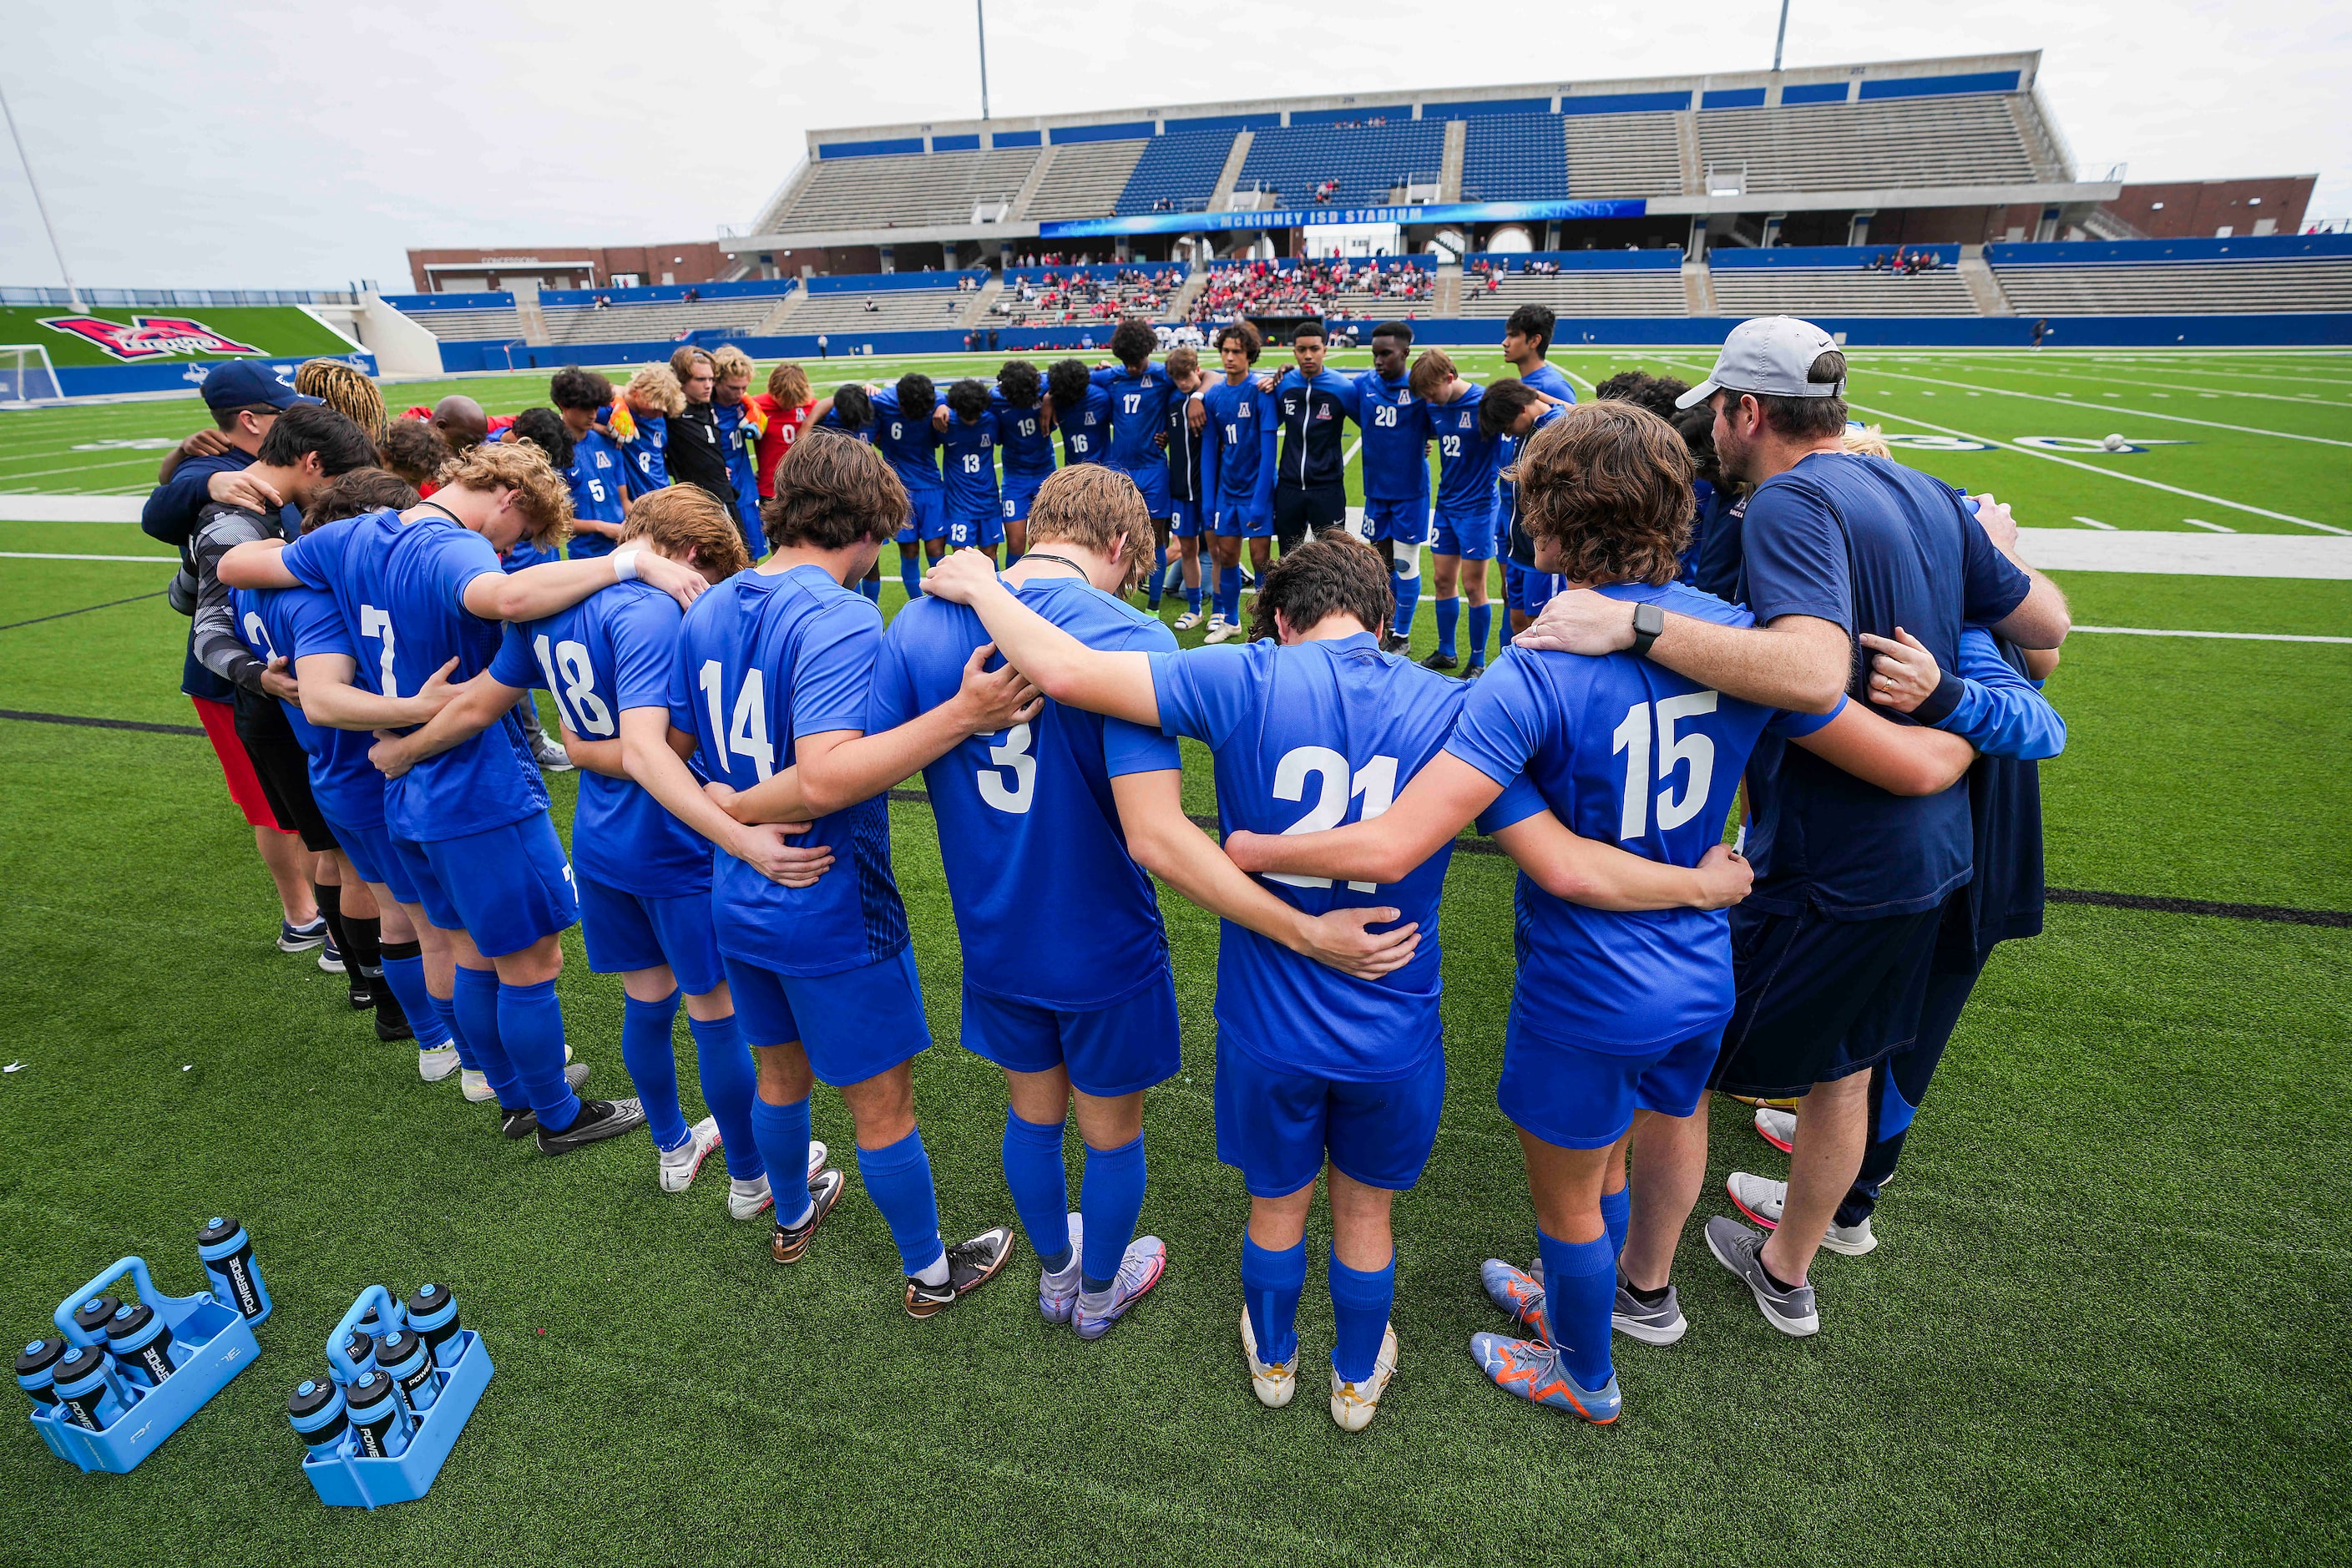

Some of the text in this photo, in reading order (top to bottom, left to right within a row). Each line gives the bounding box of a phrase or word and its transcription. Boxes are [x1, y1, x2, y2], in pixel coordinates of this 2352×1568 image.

[1220, 207, 1422, 228] McKINNEY ISD STADIUM
[1123, 394, 1141, 414] 17
[1284, 403, 1296, 415] 12
[1375, 406, 1397, 427] 20
[704, 424, 716, 443] 1
[781, 424, 796, 444] 0
[891, 422, 903, 440] 6
[1017, 417, 1035, 438] 19
[1226, 423, 1237, 444] 11
[729, 429, 743, 451] 10
[1070, 434, 1089, 453] 16
[1443, 435, 1461, 457] 22
[595, 451, 611, 468] A
[639, 452, 650, 473] 8
[962, 454, 980, 473] 13
[588, 478, 605, 502] 5
[1171, 512, 1181, 529] 9
[1362, 515, 1376, 537] 20
[950, 524, 967, 542] 13
[361, 604, 397, 698] 7
[534, 635, 615, 736] 18
[700, 659, 775, 782] 14
[975, 722, 1037, 814] 3
[1612, 690, 1718, 842] 15
[1261, 746, 1399, 894] 21
[228, 1256, 257, 1315] POWERADE
